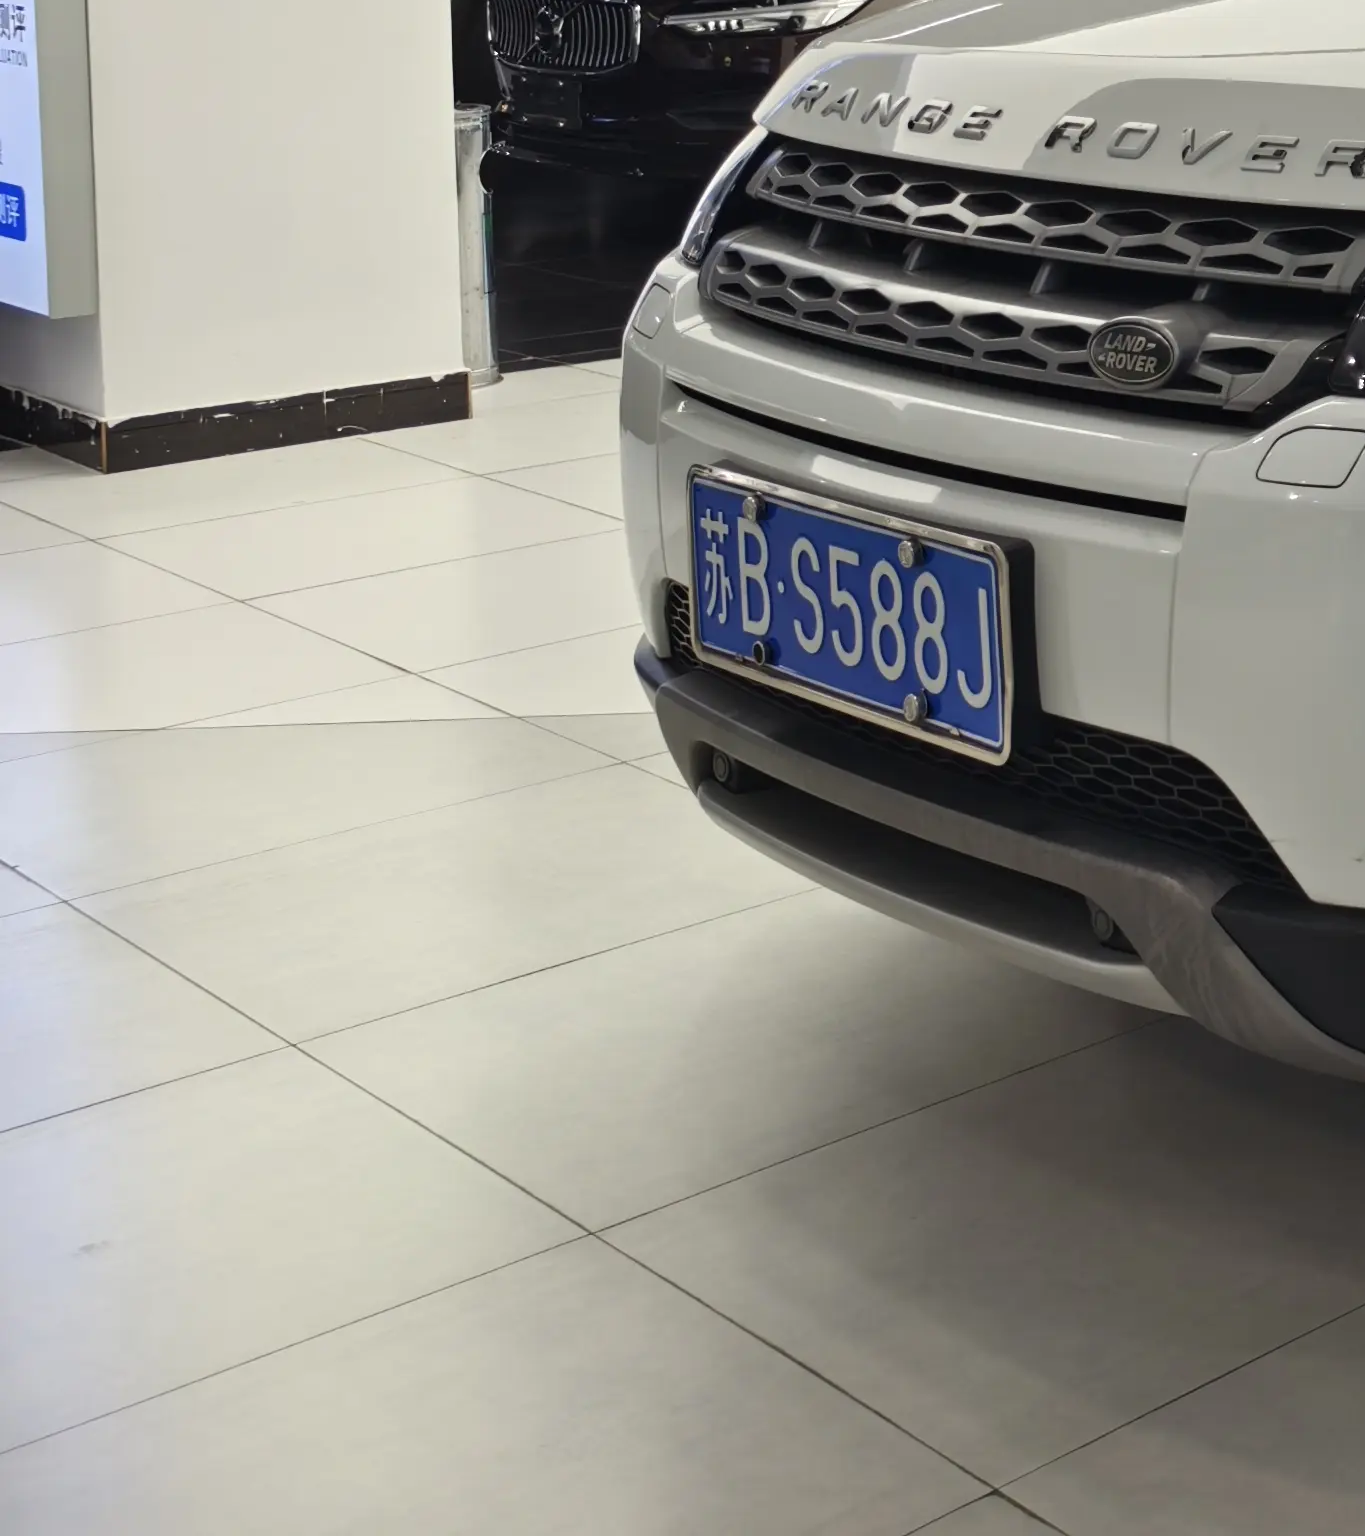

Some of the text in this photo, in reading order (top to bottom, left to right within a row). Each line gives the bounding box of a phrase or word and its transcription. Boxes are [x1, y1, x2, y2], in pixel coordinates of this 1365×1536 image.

[791, 79, 1003, 141] RANGE
[1103, 332, 1147, 352] LAND
[1105, 351, 1157, 374] ROVER
